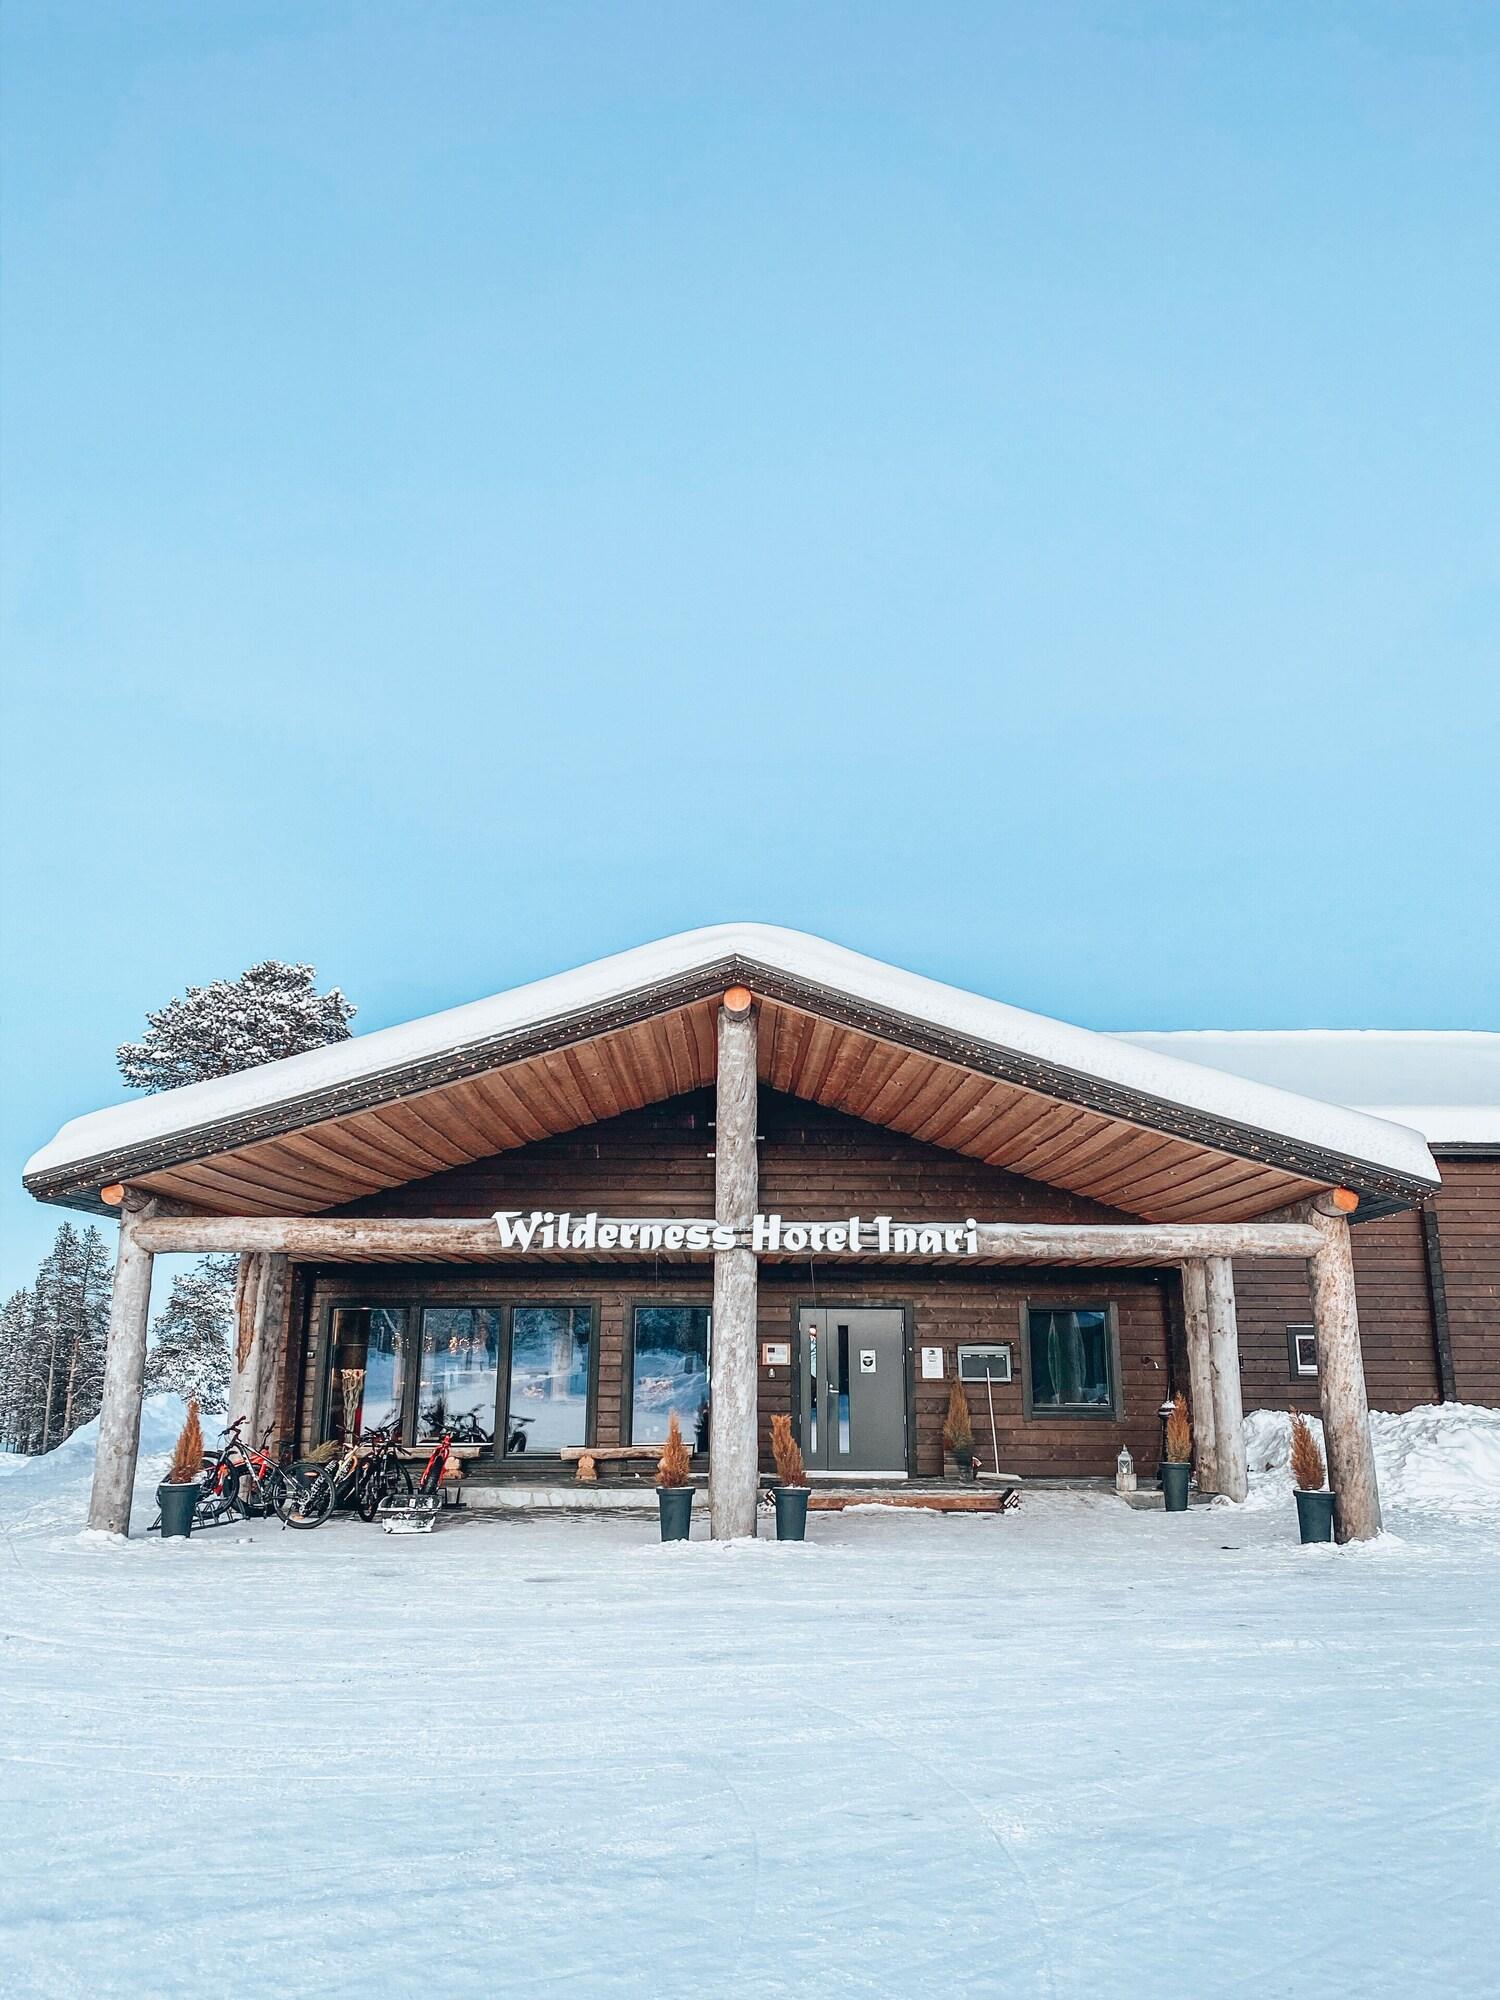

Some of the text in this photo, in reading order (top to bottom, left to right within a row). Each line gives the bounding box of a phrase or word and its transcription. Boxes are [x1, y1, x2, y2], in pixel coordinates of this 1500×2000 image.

[491, 1211, 978, 1254] Wilderness Hotel Inari
